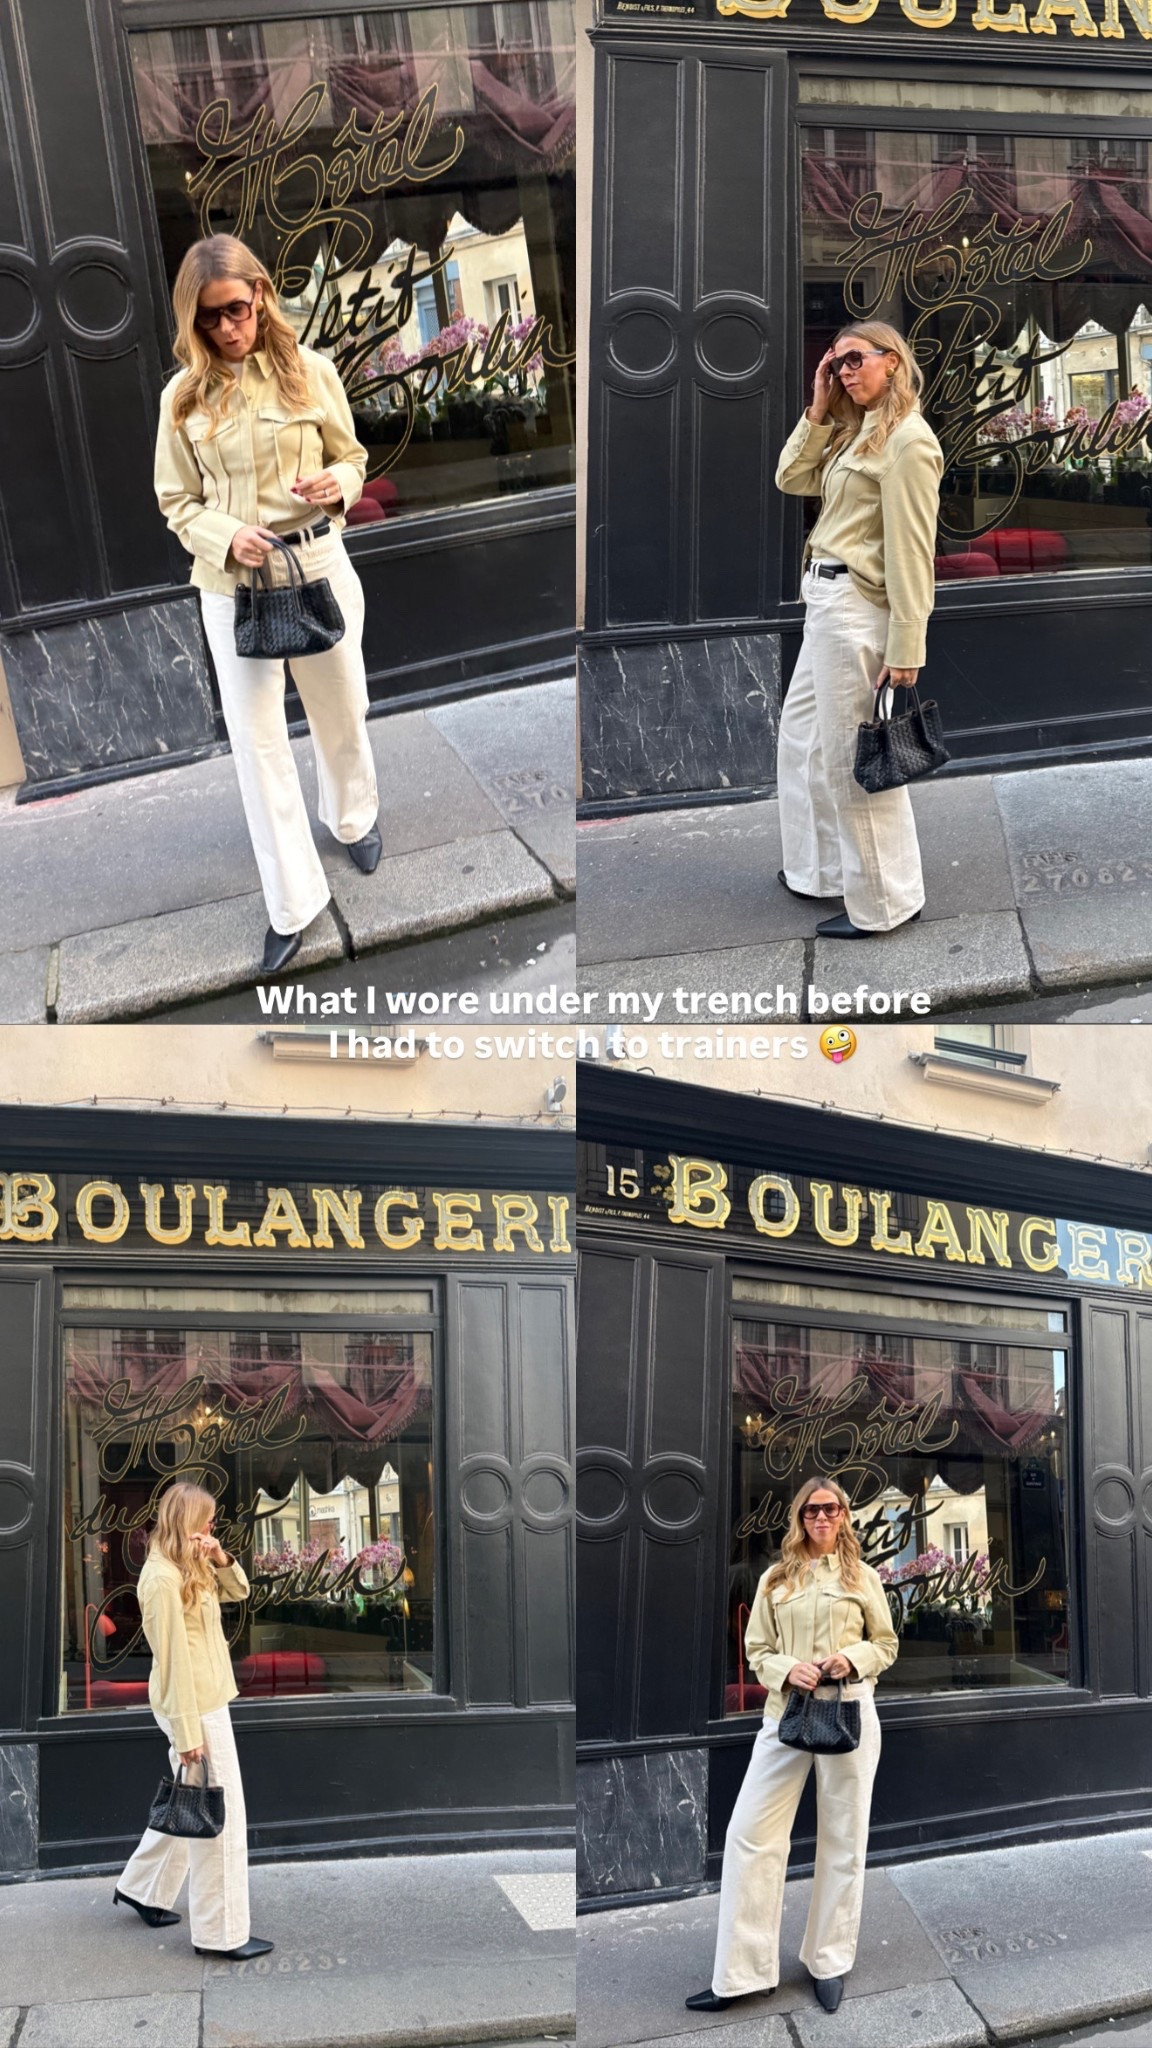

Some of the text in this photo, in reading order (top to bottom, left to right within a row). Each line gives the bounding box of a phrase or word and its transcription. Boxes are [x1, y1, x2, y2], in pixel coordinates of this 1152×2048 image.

[188, 81, 465, 240] Hôtel
[835, 187, 1092, 320] Hôtel
[0, 1172, 571, 1253] BOULANGERI
[606, 1154, 1152, 1291] 15 BOULANGER
[91, 1375, 306, 1483] Hôtel
[759, 1375, 959, 1480] Hôtel
